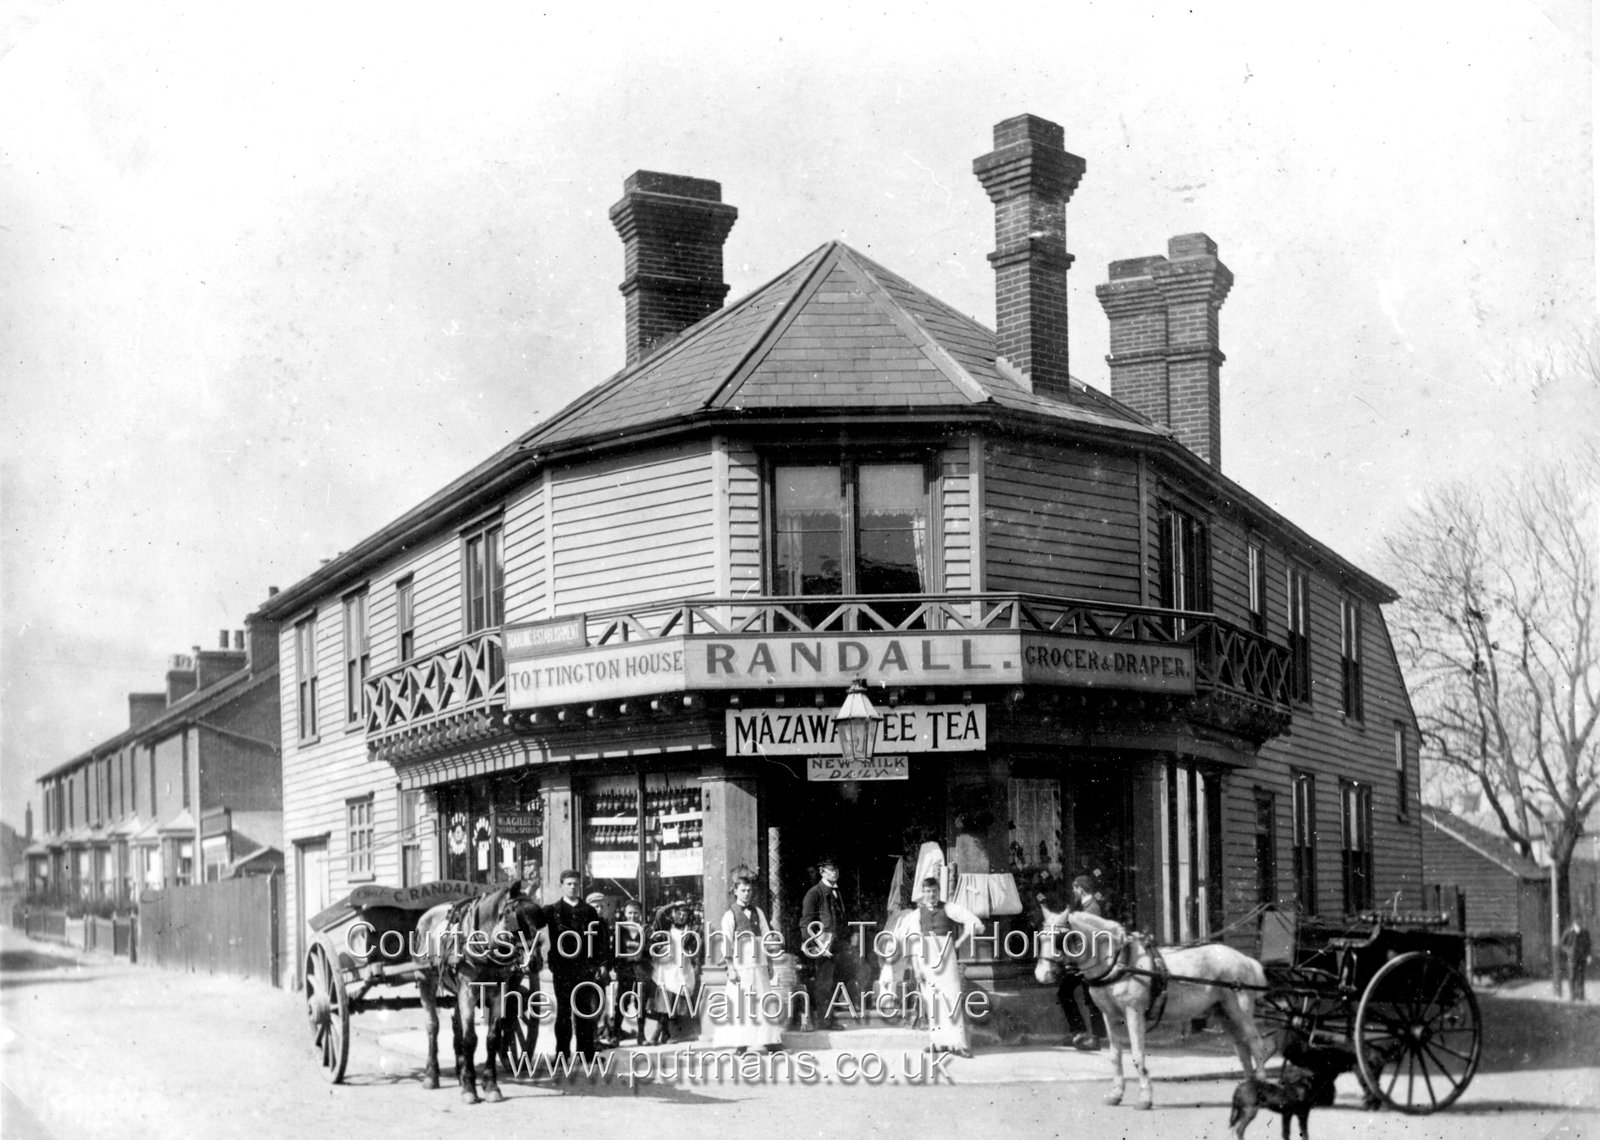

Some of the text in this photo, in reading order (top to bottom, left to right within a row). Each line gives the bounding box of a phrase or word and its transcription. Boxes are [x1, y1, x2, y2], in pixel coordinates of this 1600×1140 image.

[511, 650, 683, 691] TOTTINGTON HOUSE
[706, 639, 1012, 674] RANDALL.
[1025, 645, 1098, 671] GROCER
[1114, 652, 1190, 678] DRAPER.
[927, 710, 980, 749] TEA
[812, 757, 905, 769] NEW MILK
[829, 769, 888, 779] DAILY
